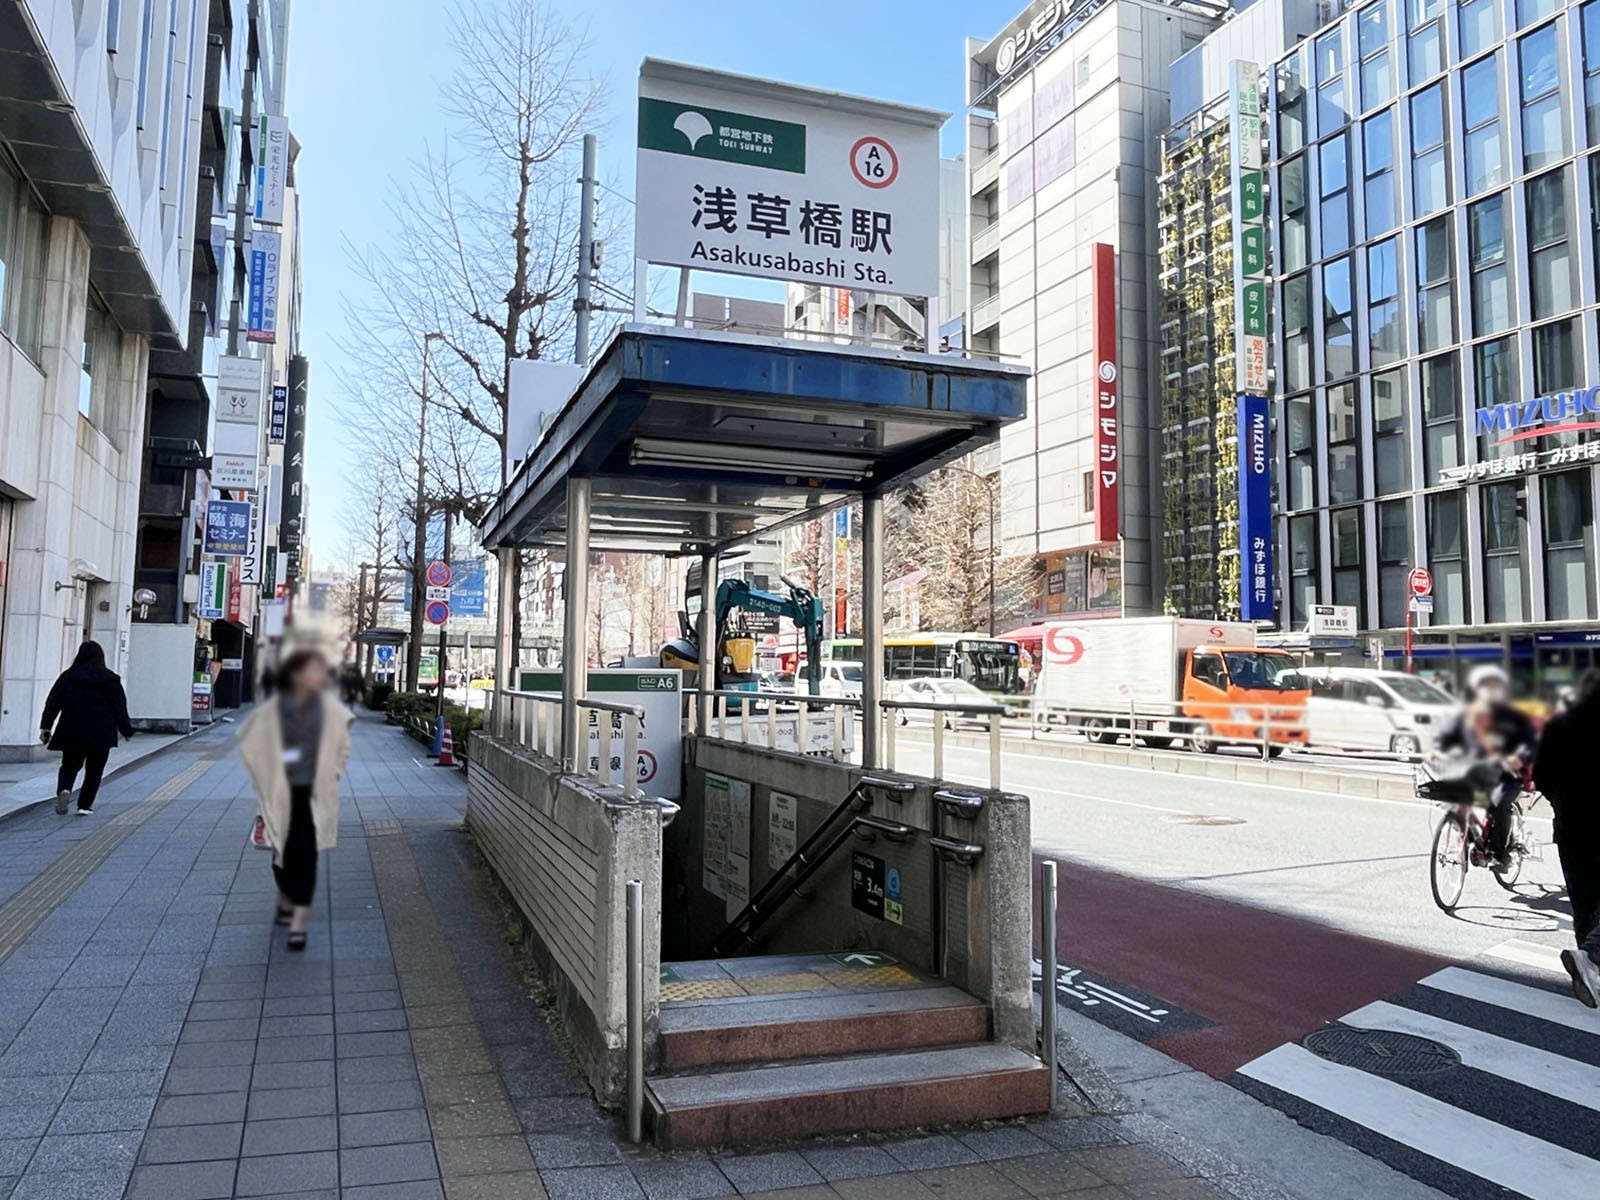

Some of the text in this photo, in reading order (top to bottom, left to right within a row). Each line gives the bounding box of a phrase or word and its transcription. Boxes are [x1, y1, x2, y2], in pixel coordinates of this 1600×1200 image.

[719, 126, 774, 145] 都営地下鉄
[719, 138, 773, 154] TOEI SUBWAY
[865, 161, 885, 178] 16
[868, 146, 880, 160] A
[1246, 183, 1256, 210] 内科
[691, 184, 893, 256] 浅草橋駅
[691, 241, 894, 285] Asakusabashi Sta.
[1249, 291, 1260, 329] 皮フ科
[1253, 339, 1265, 388] 処方せん
[1100, 392, 1117, 488] シモジマ
[1253, 413, 1265, 474] MIZUHO
[1460, 451, 1538, 479] みずほ銀行
[209, 528, 246, 540] セミナー
[204, 564, 214, 608] FamilyMart
[1253, 537, 1267, 603] みずほ銀行
[657, 677, 673, 688] A6
